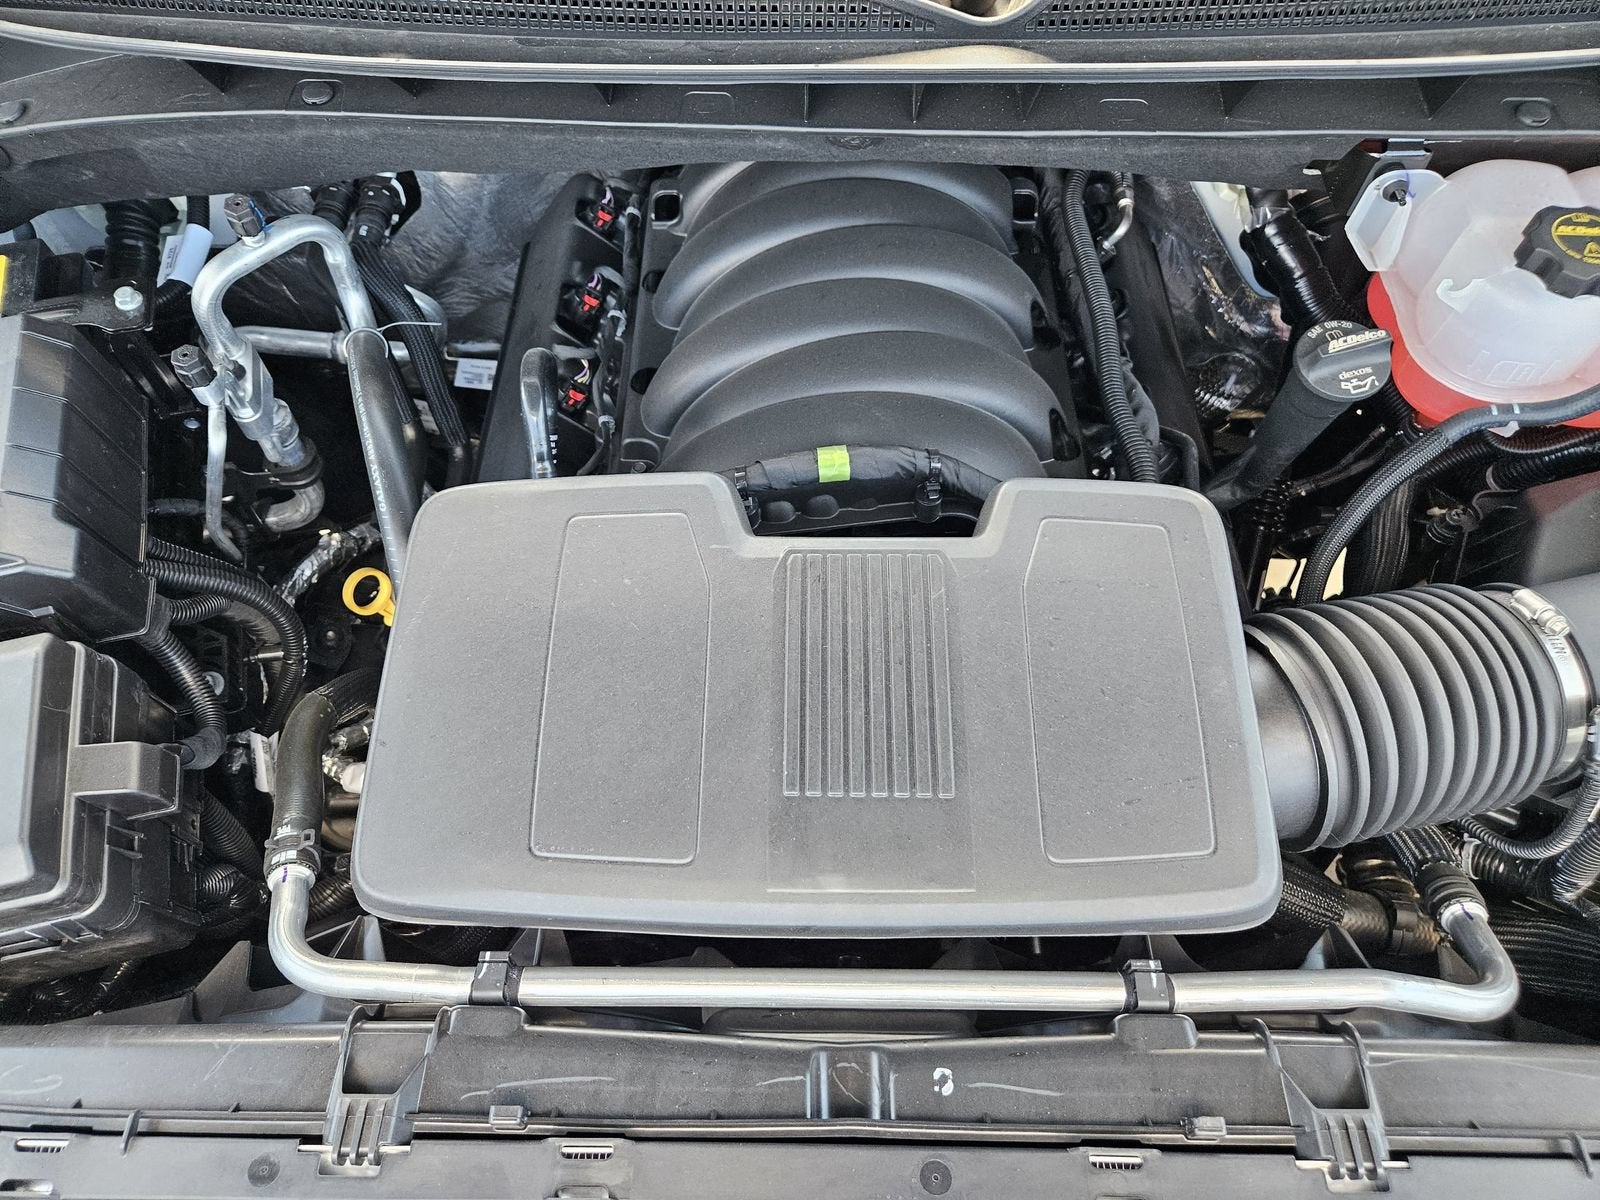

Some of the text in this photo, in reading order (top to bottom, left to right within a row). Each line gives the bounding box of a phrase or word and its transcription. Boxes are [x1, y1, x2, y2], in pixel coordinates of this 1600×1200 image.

[1307, 325, 1323, 339] SAE
[1329, 330, 1386, 350] ACDelco
[1338, 366, 1373, 380] dexos
